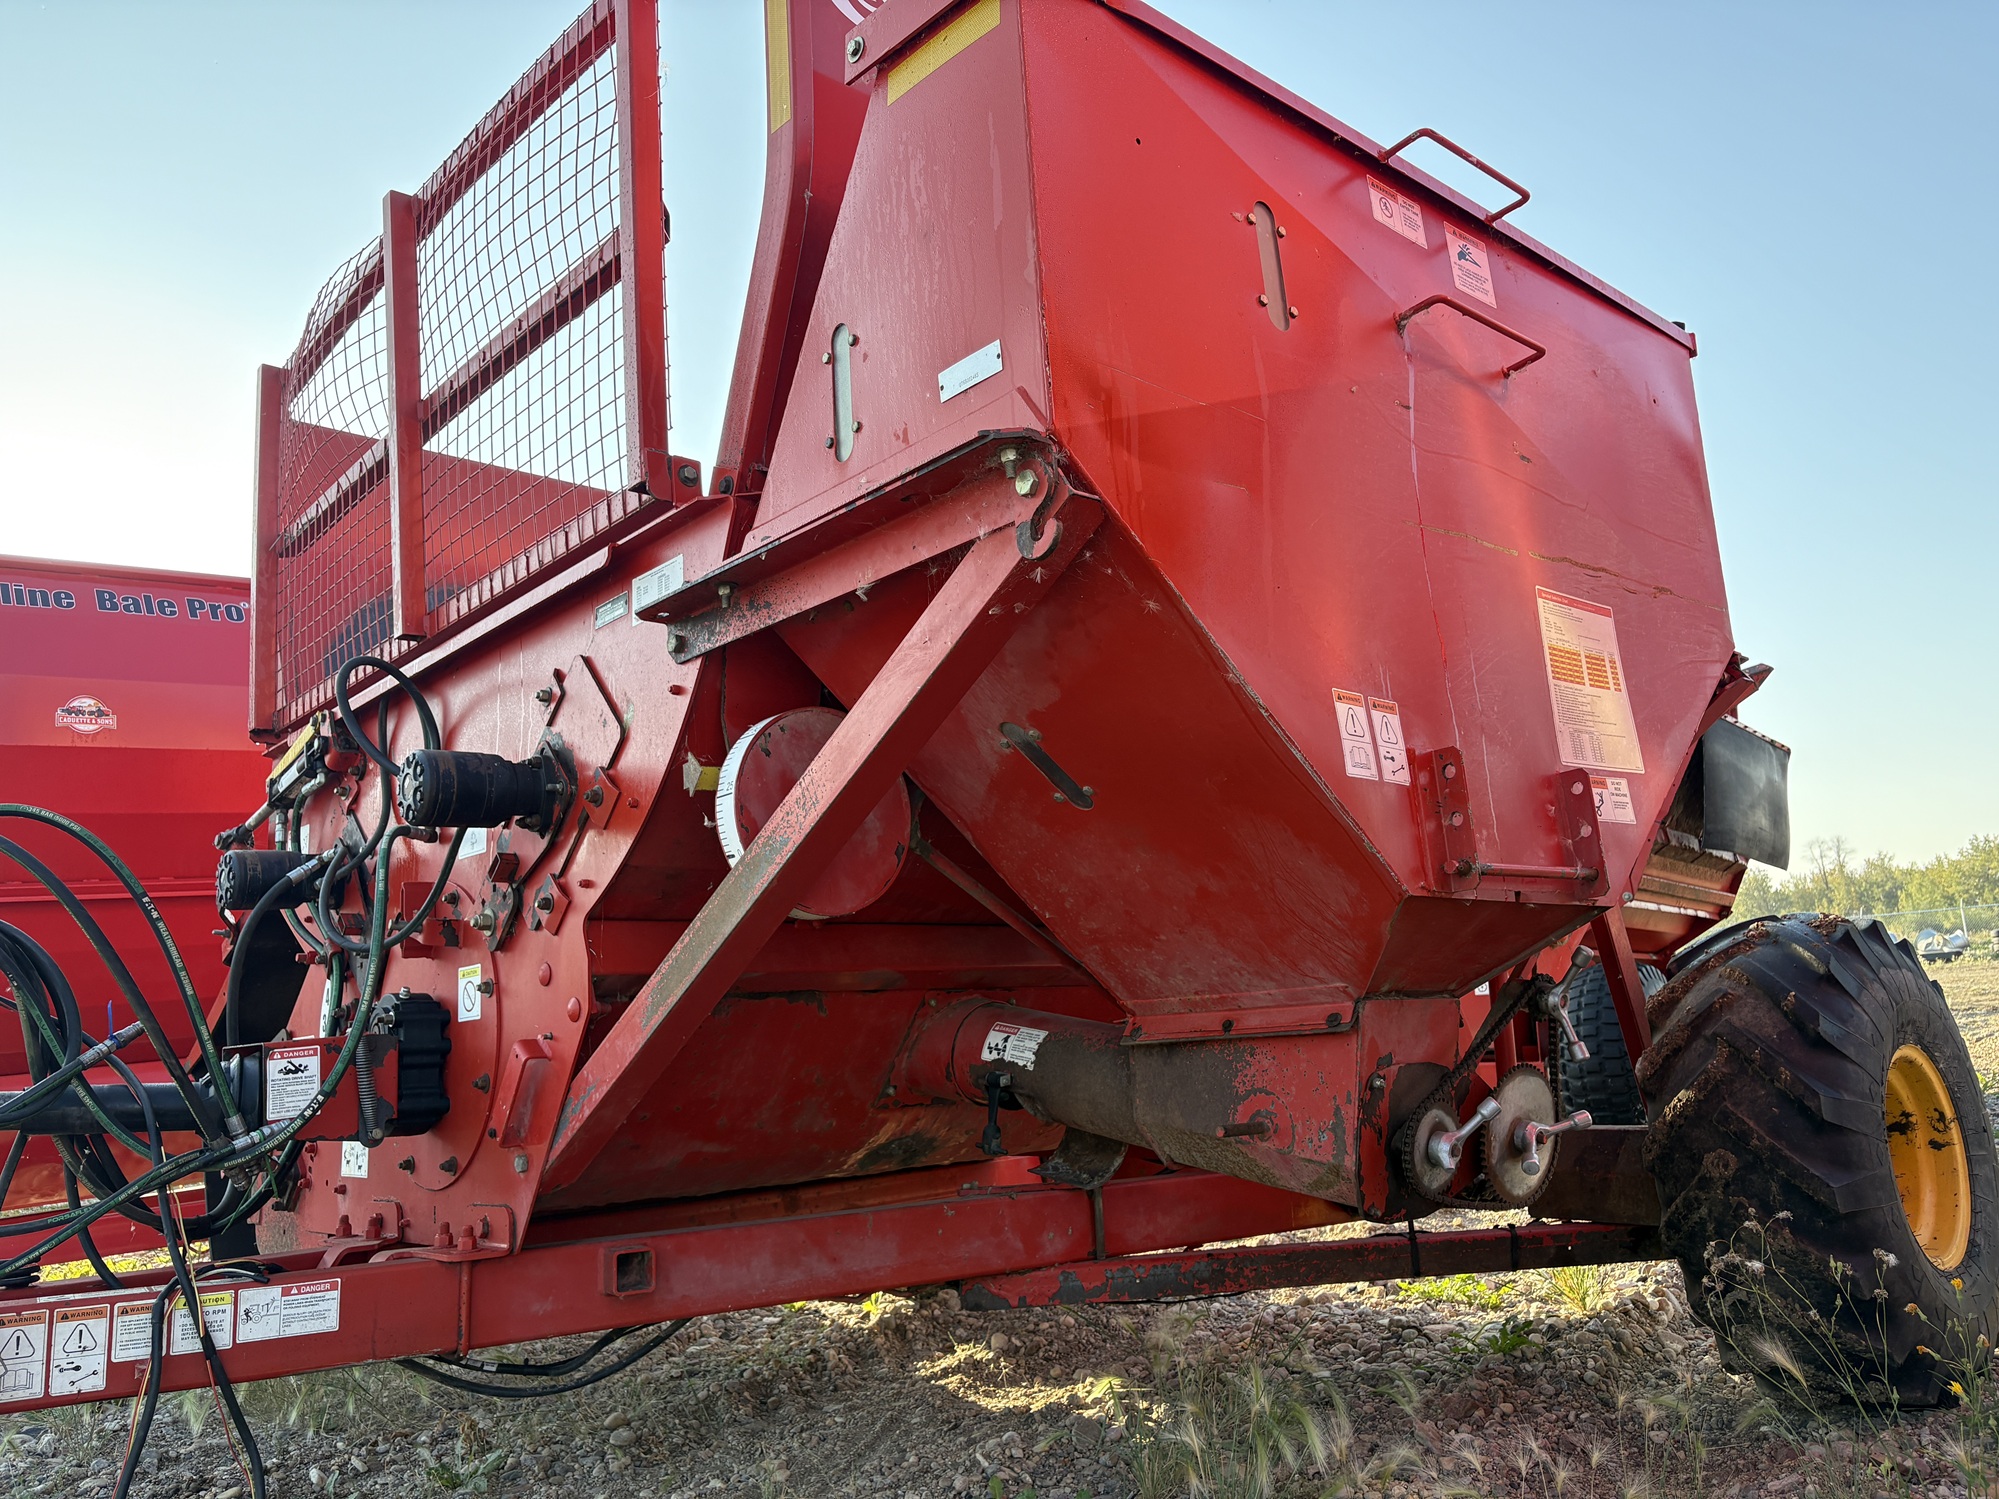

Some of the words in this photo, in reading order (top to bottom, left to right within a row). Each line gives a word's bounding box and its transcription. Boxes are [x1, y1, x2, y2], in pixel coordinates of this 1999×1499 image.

[94, 589, 178, 618] Bale
[1342, 694, 1361, 704] WARNING
[1377, 703, 1395, 712] WARNING
[41, 810, 54, 818] BAR
[157, 921, 182, 968] WEATHERHEAD
[300, 1284, 331, 1293] DANGER
[70, 1310, 103, 1319] WARNING
[7, 1316, 42, 1325] WARNING
